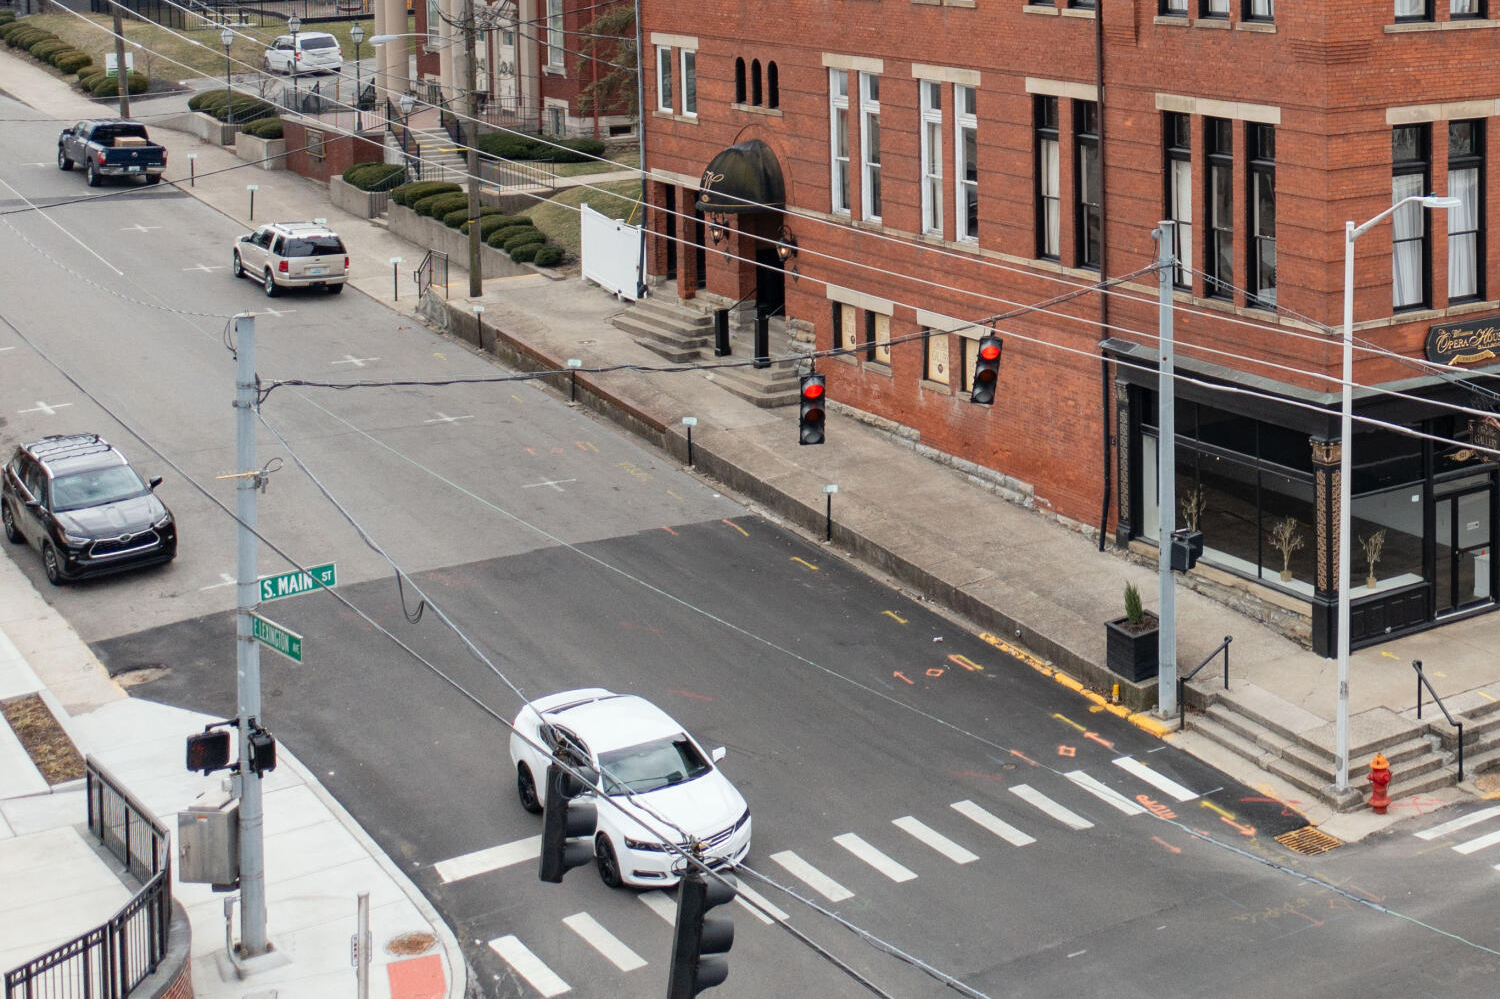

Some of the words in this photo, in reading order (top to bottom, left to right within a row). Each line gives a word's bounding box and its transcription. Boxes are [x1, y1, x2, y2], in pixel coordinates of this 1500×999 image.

[263, 579, 276, 599] S.
[278, 570, 313, 596] MAIN
[321, 570, 332, 582] ST
[260, 621, 290, 654] LEXINGTON
